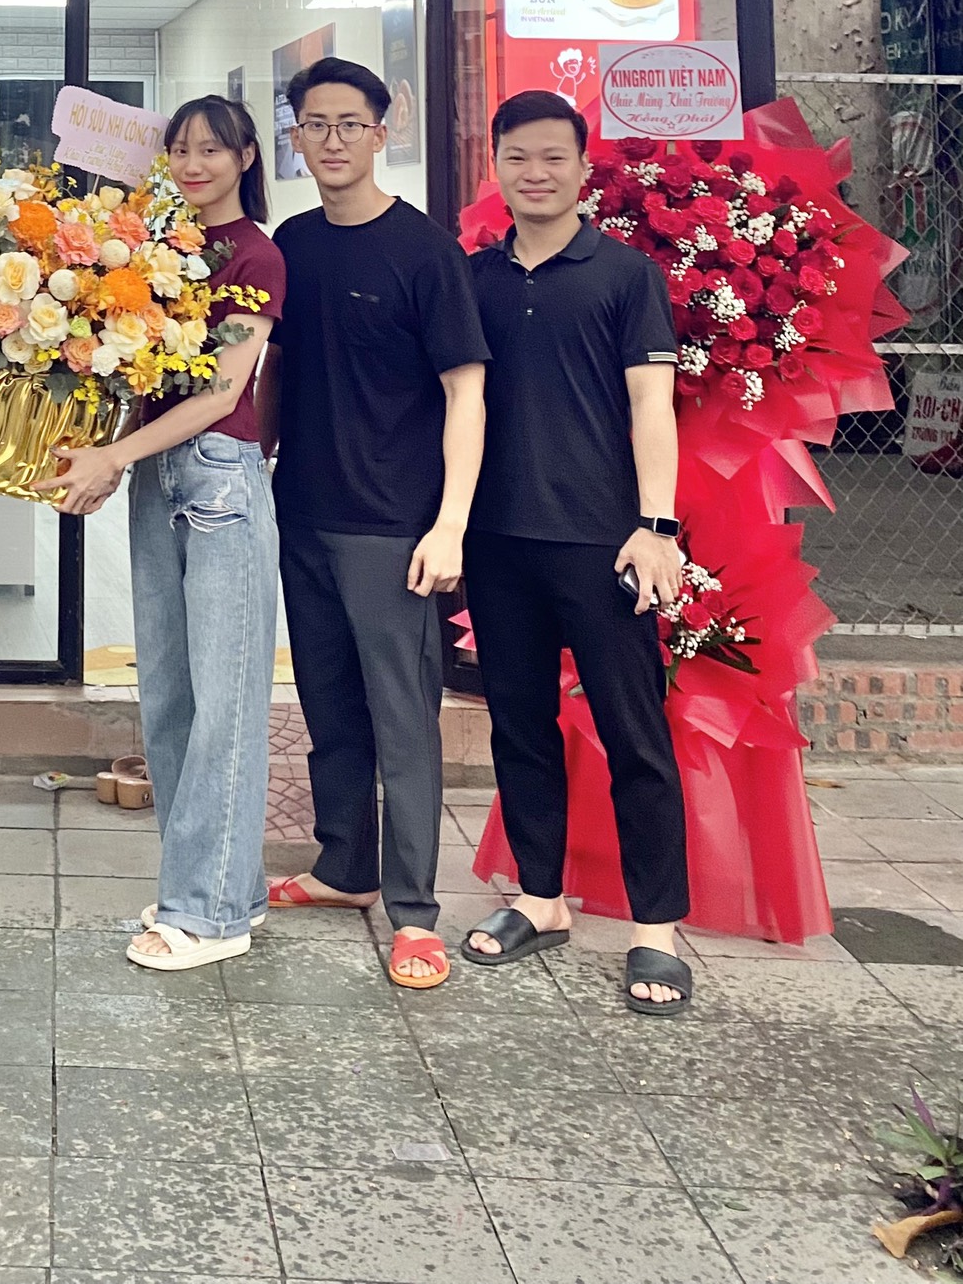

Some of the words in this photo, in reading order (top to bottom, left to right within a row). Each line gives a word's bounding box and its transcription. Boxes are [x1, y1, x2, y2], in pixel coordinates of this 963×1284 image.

[610, 69, 666, 88] KINGROTI
[668, 65, 694, 91] VIỆT
[697, 68, 727, 87] NAM
